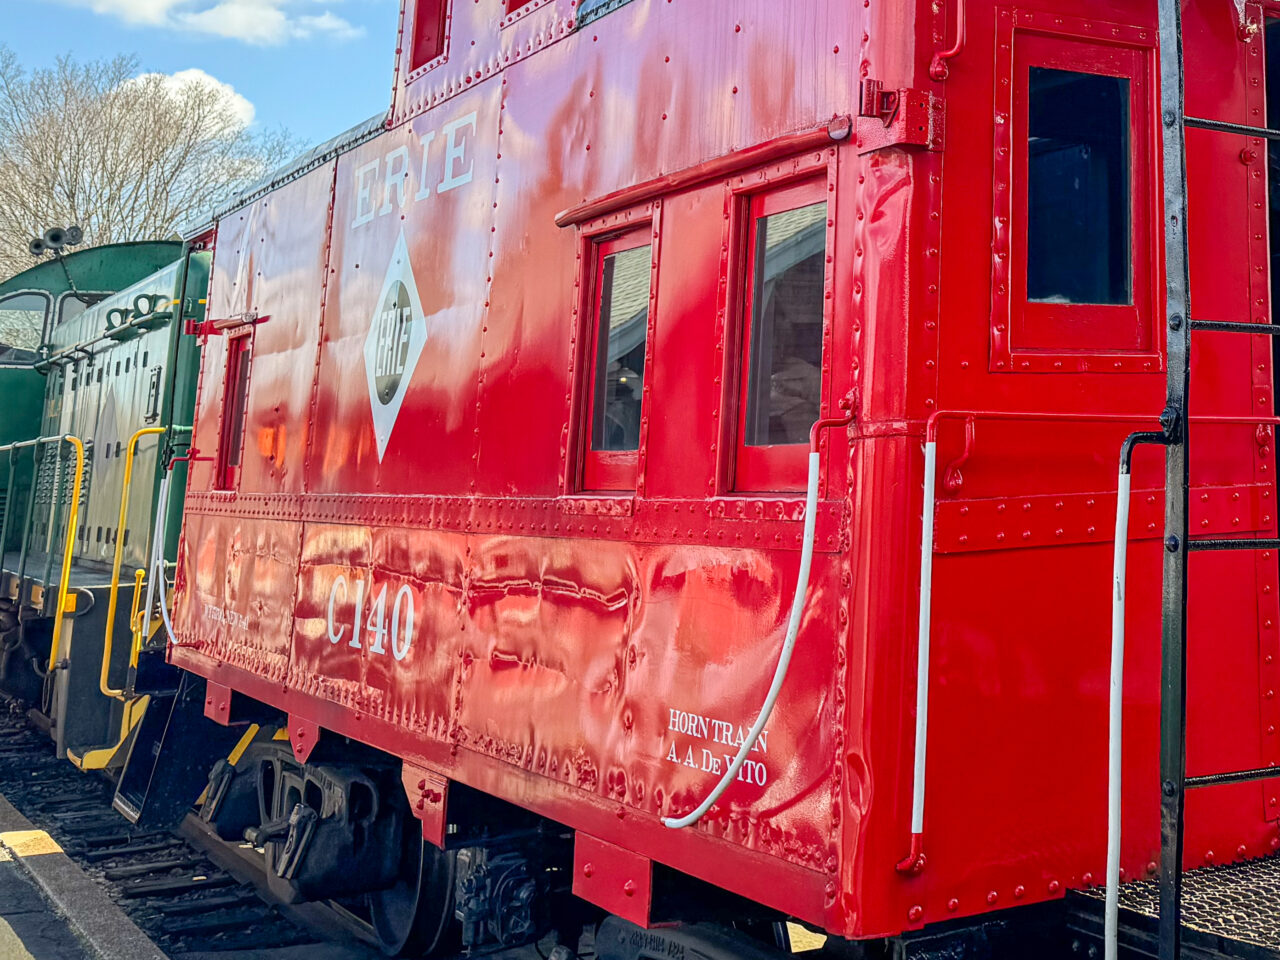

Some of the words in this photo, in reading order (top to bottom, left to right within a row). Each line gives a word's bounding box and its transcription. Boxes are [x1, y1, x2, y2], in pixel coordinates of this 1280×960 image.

[352, 112, 476, 228] ERIE
[375, 307, 411, 376] ERIE
[328, 574, 414, 660] C140
[667, 741, 681, 763] A.
[684, 745, 698, 769] A.
[668, 708, 710, 739] HORN
[711, 720, 769, 753] TRAN
